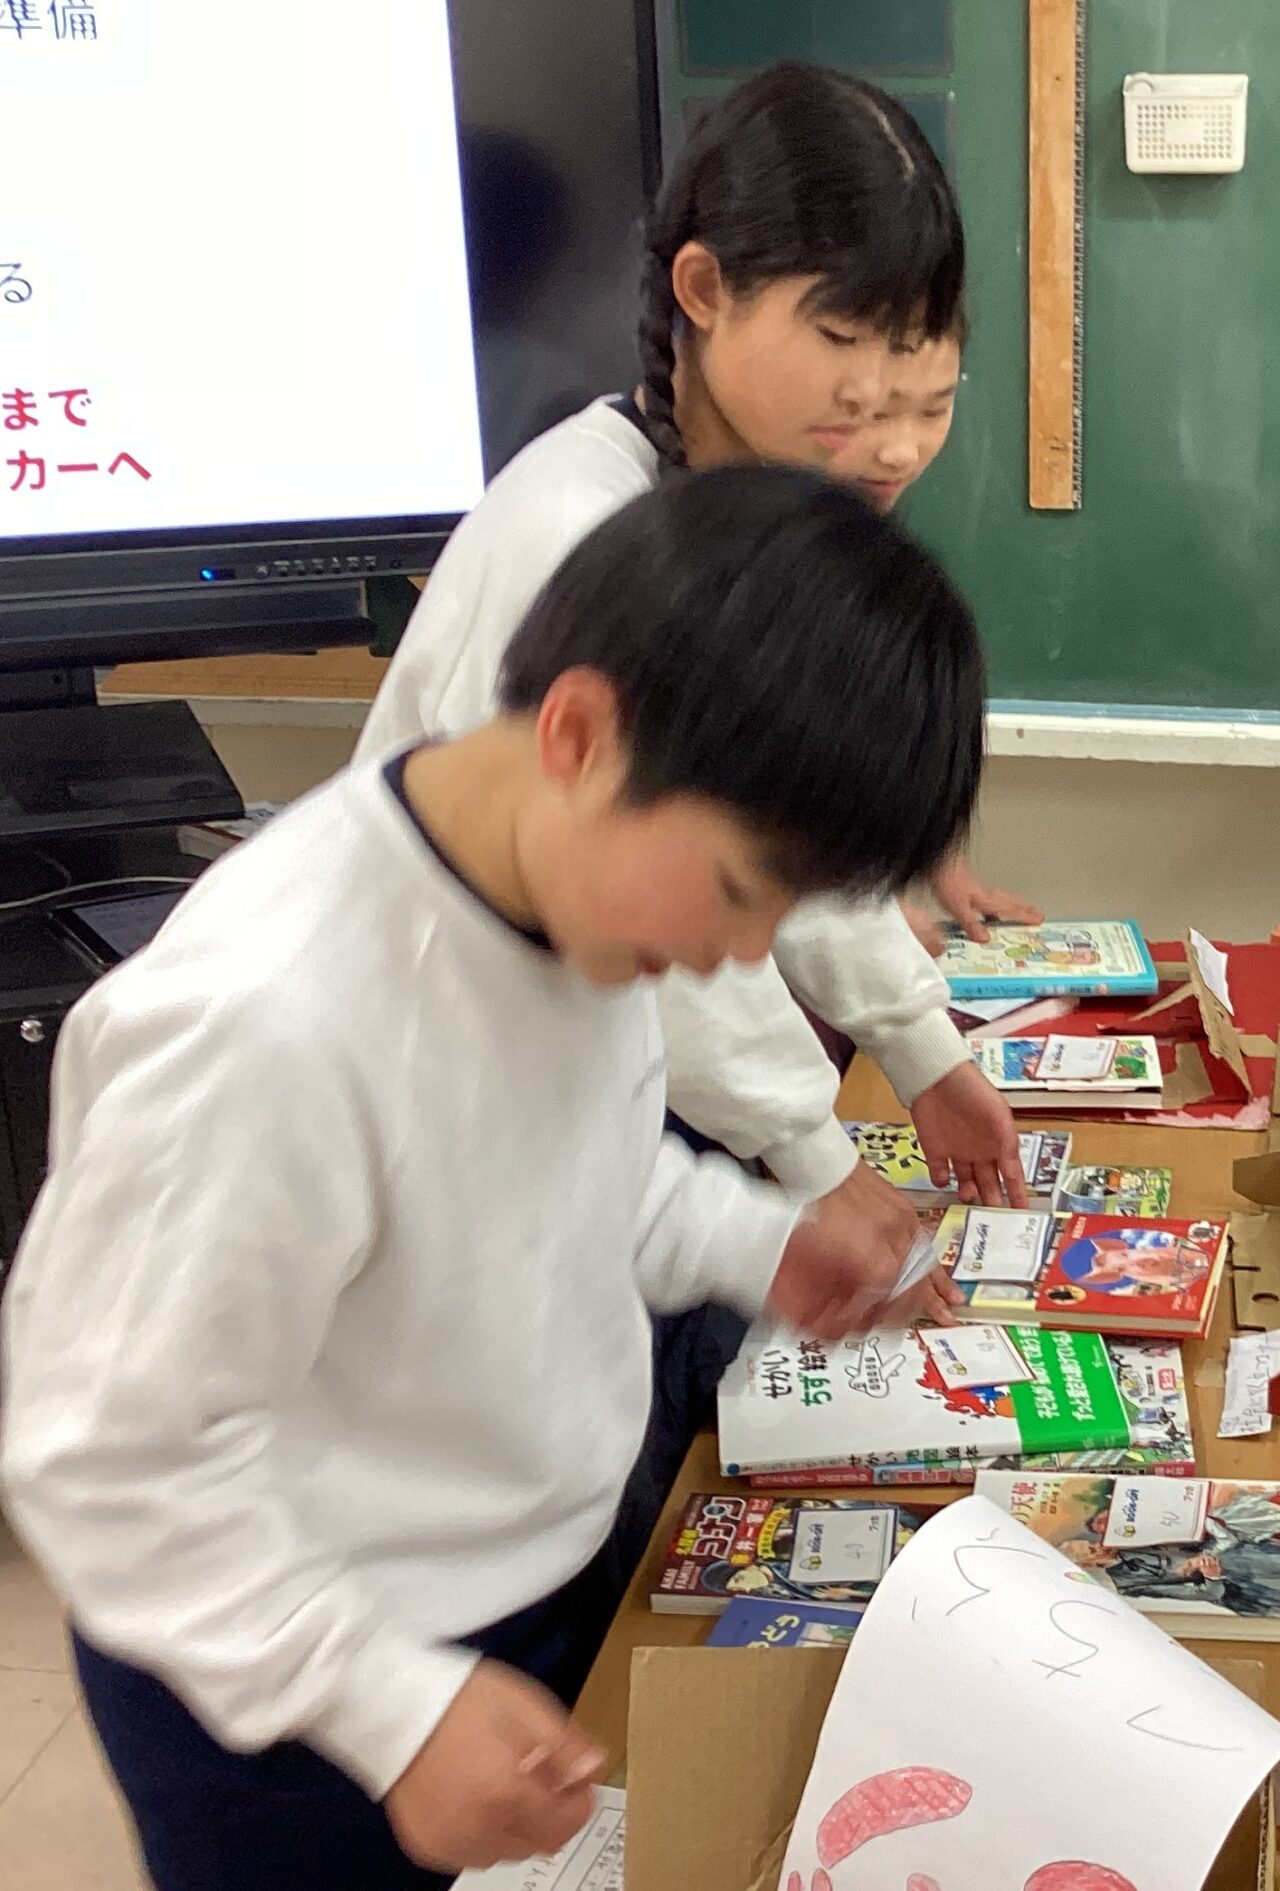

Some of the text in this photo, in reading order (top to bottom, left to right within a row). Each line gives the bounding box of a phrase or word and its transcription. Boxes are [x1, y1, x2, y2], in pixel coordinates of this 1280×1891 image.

[2, 388, 93, 430] まで
[6, 450, 152, 491] カーへ
[759, 1349, 792, 1399] せかい
[796, 1338, 833, 1407] ちず絵本
[691, 1496, 747, 1560] コナン
[660, 1567, 677, 1590] AKAI
[674, 1559, 696, 1590] FAMILY
